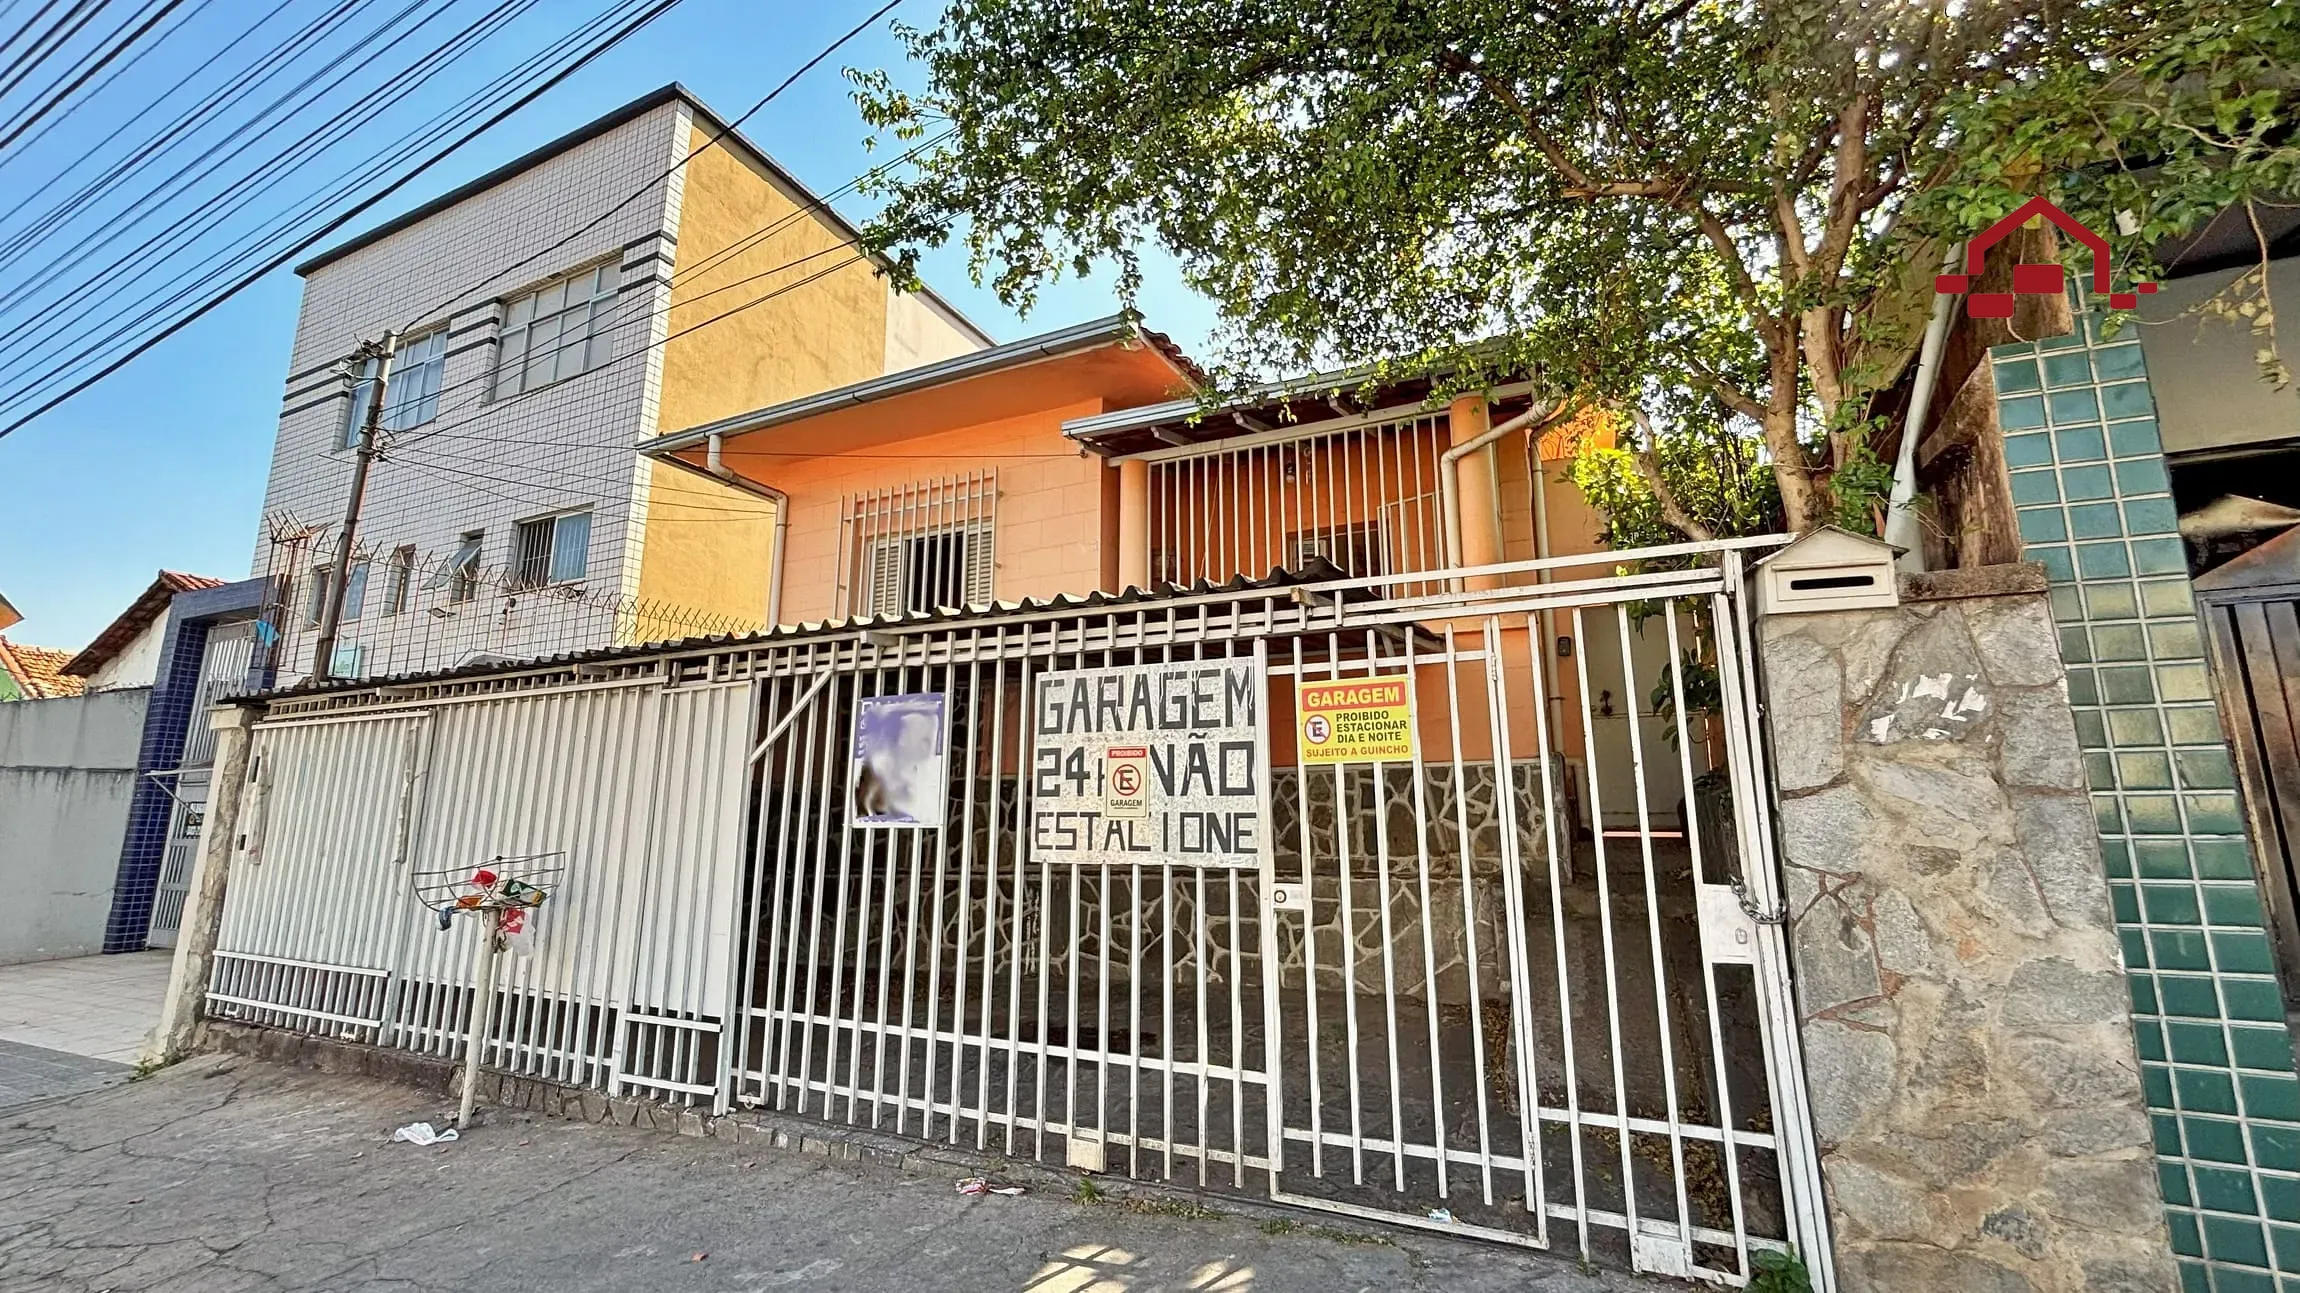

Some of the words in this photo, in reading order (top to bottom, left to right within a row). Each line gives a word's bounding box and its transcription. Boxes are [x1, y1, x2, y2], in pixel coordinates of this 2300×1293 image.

[1038, 666, 1256, 735] GARAGEM
[1307, 686, 1400, 708] GARAGEM
[1336, 710, 1389, 722] PROIBIDO
[1336, 720, 1407, 732] ESTACIONAR
[1337, 734, 1356, 743] DIA
[1359, 733, 1365, 742] E
[1369, 731, 1402, 742] NOITE
[1306, 747, 1348, 757] SUJEITO
[1351, 747, 1358, 756] A
[1360, 745, 1409, 755] GUINCHO
[1150, 732, 1256, 796] NÃO
[1110, 799, 1143, 807] GARAGEM
